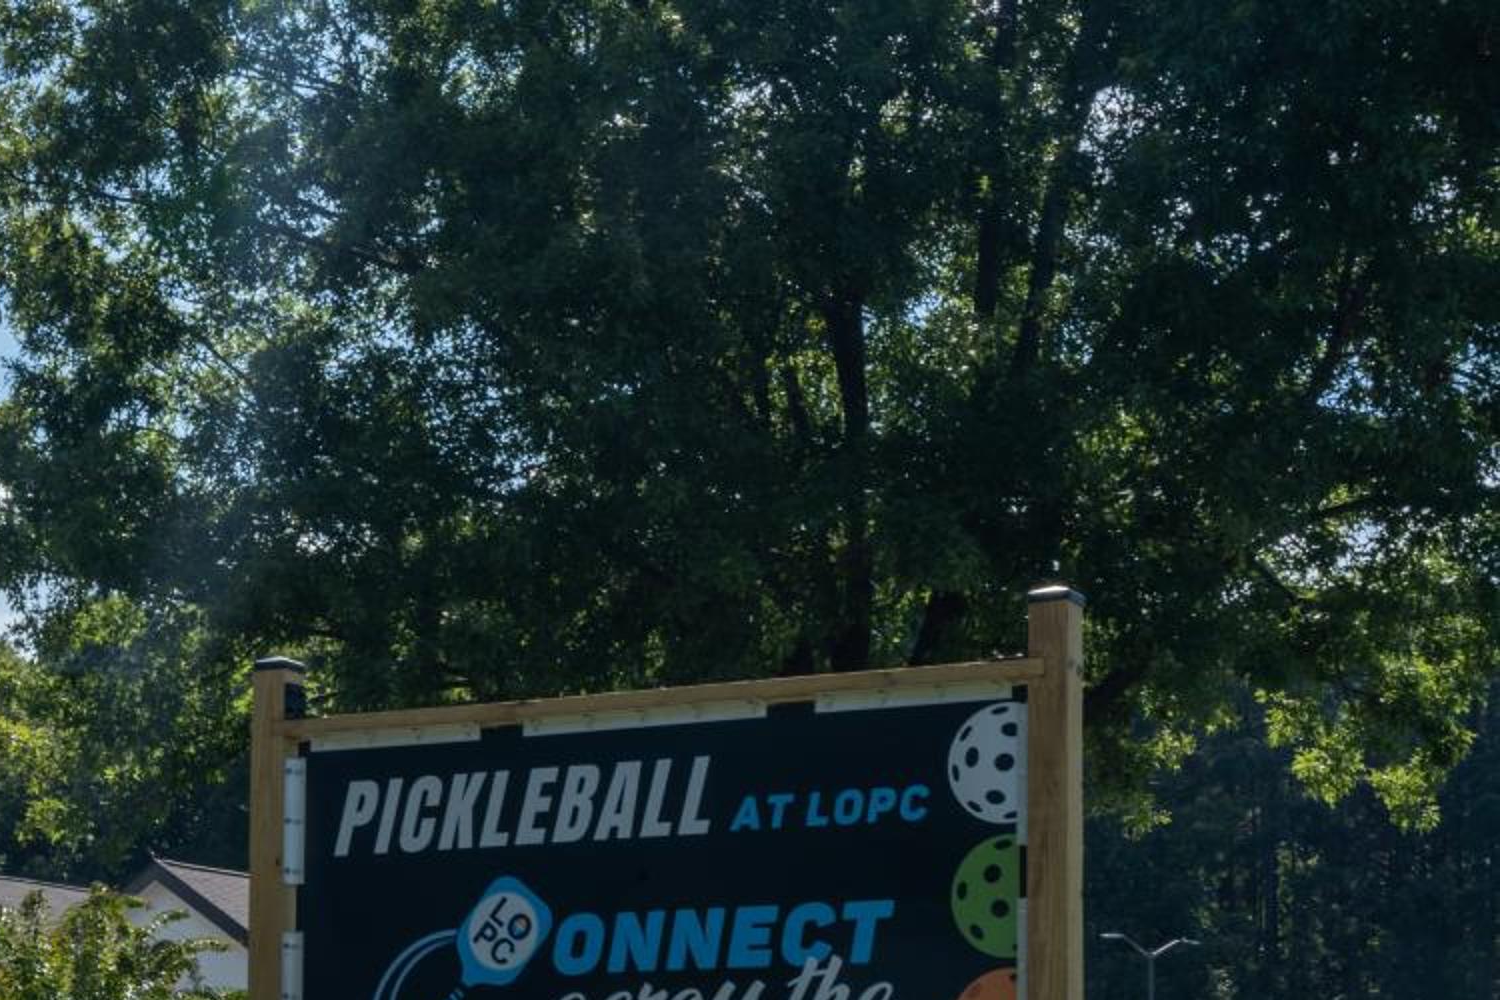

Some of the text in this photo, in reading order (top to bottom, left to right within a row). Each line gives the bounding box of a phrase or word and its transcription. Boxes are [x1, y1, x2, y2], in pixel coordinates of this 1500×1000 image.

[334, 755, 931, 857] PICKLEBALL AT LOPC
